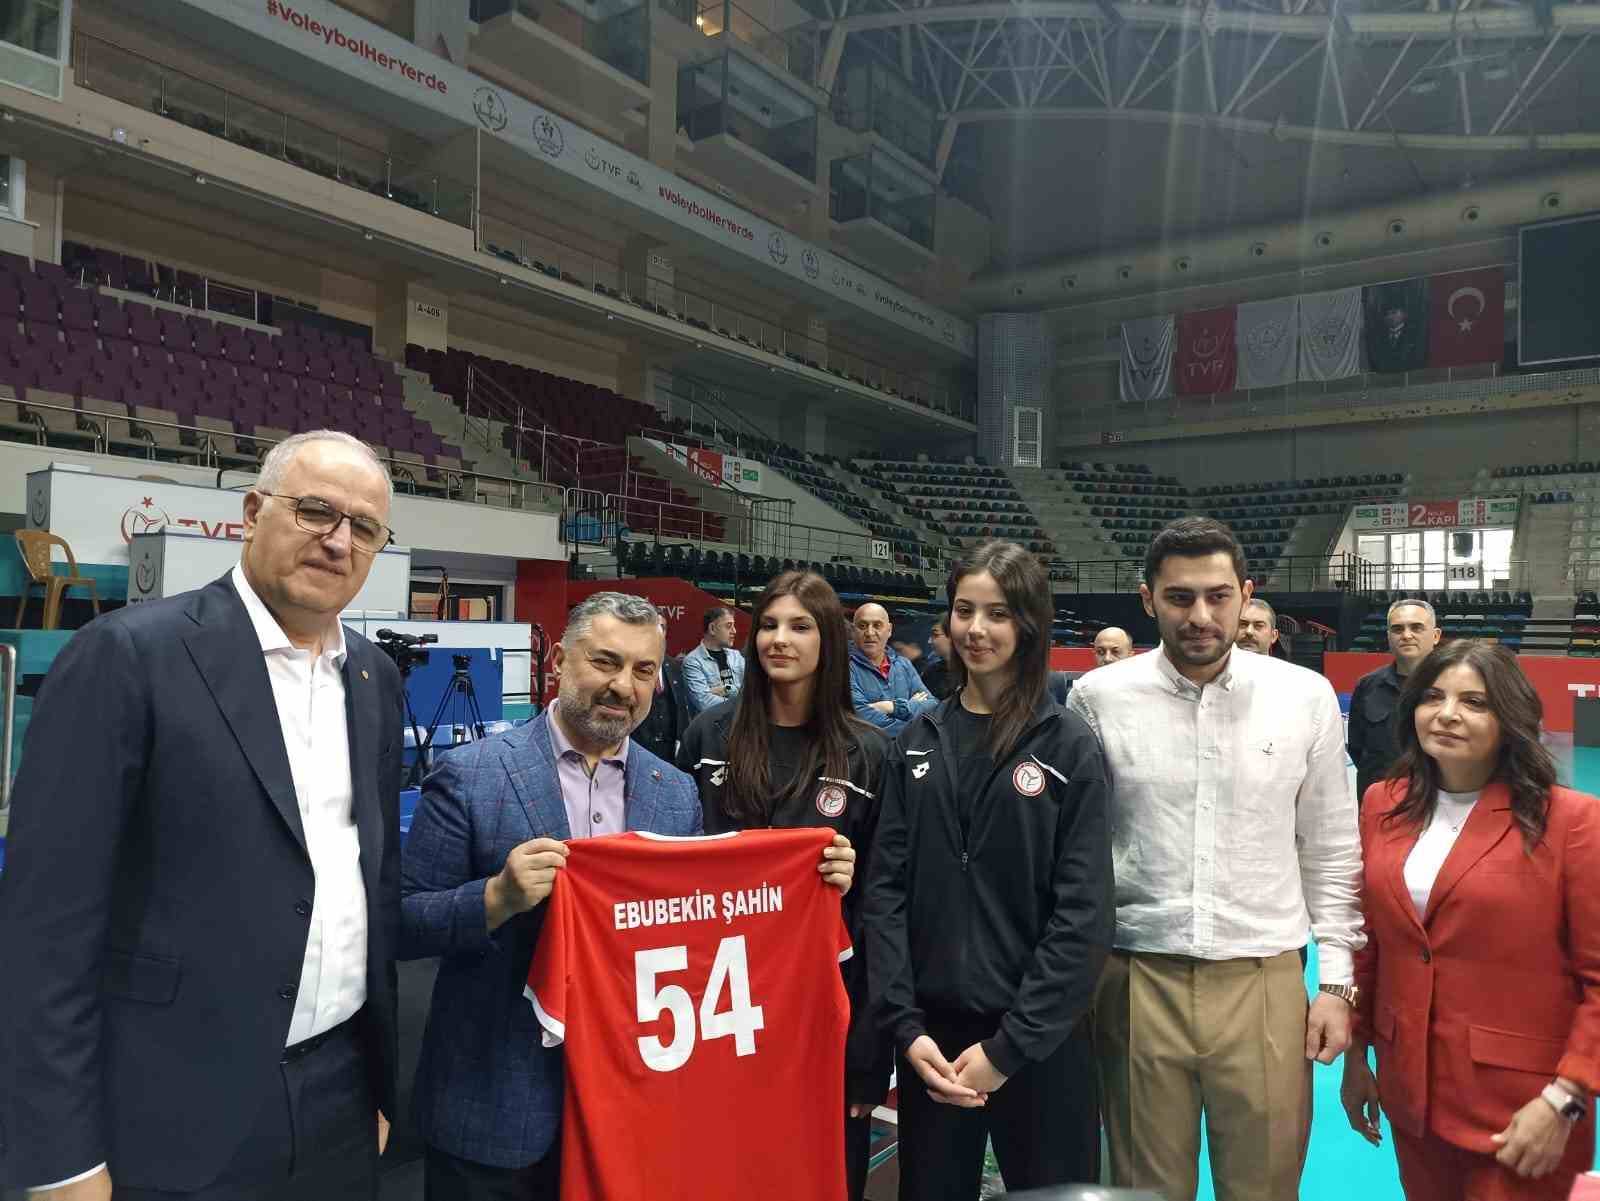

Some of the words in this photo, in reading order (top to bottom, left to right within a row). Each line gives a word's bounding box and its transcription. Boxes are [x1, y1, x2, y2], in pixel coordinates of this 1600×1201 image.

[267, 0, 448, 94] #VoleybolHerYerde
[1187, 359, 1224, 378] TVF
[1411, 504, 1426, 526] 2
[1428, 515, 1456, 525] KAPI
[875, 543, 888, 556] 121
[1451, 567, 1476, 579] 118
[614, 888, 716, 930] EBUBEKİR
[722, 881, 783, 924] ŞAHİN
[634, 934, 765, 1073] 54
